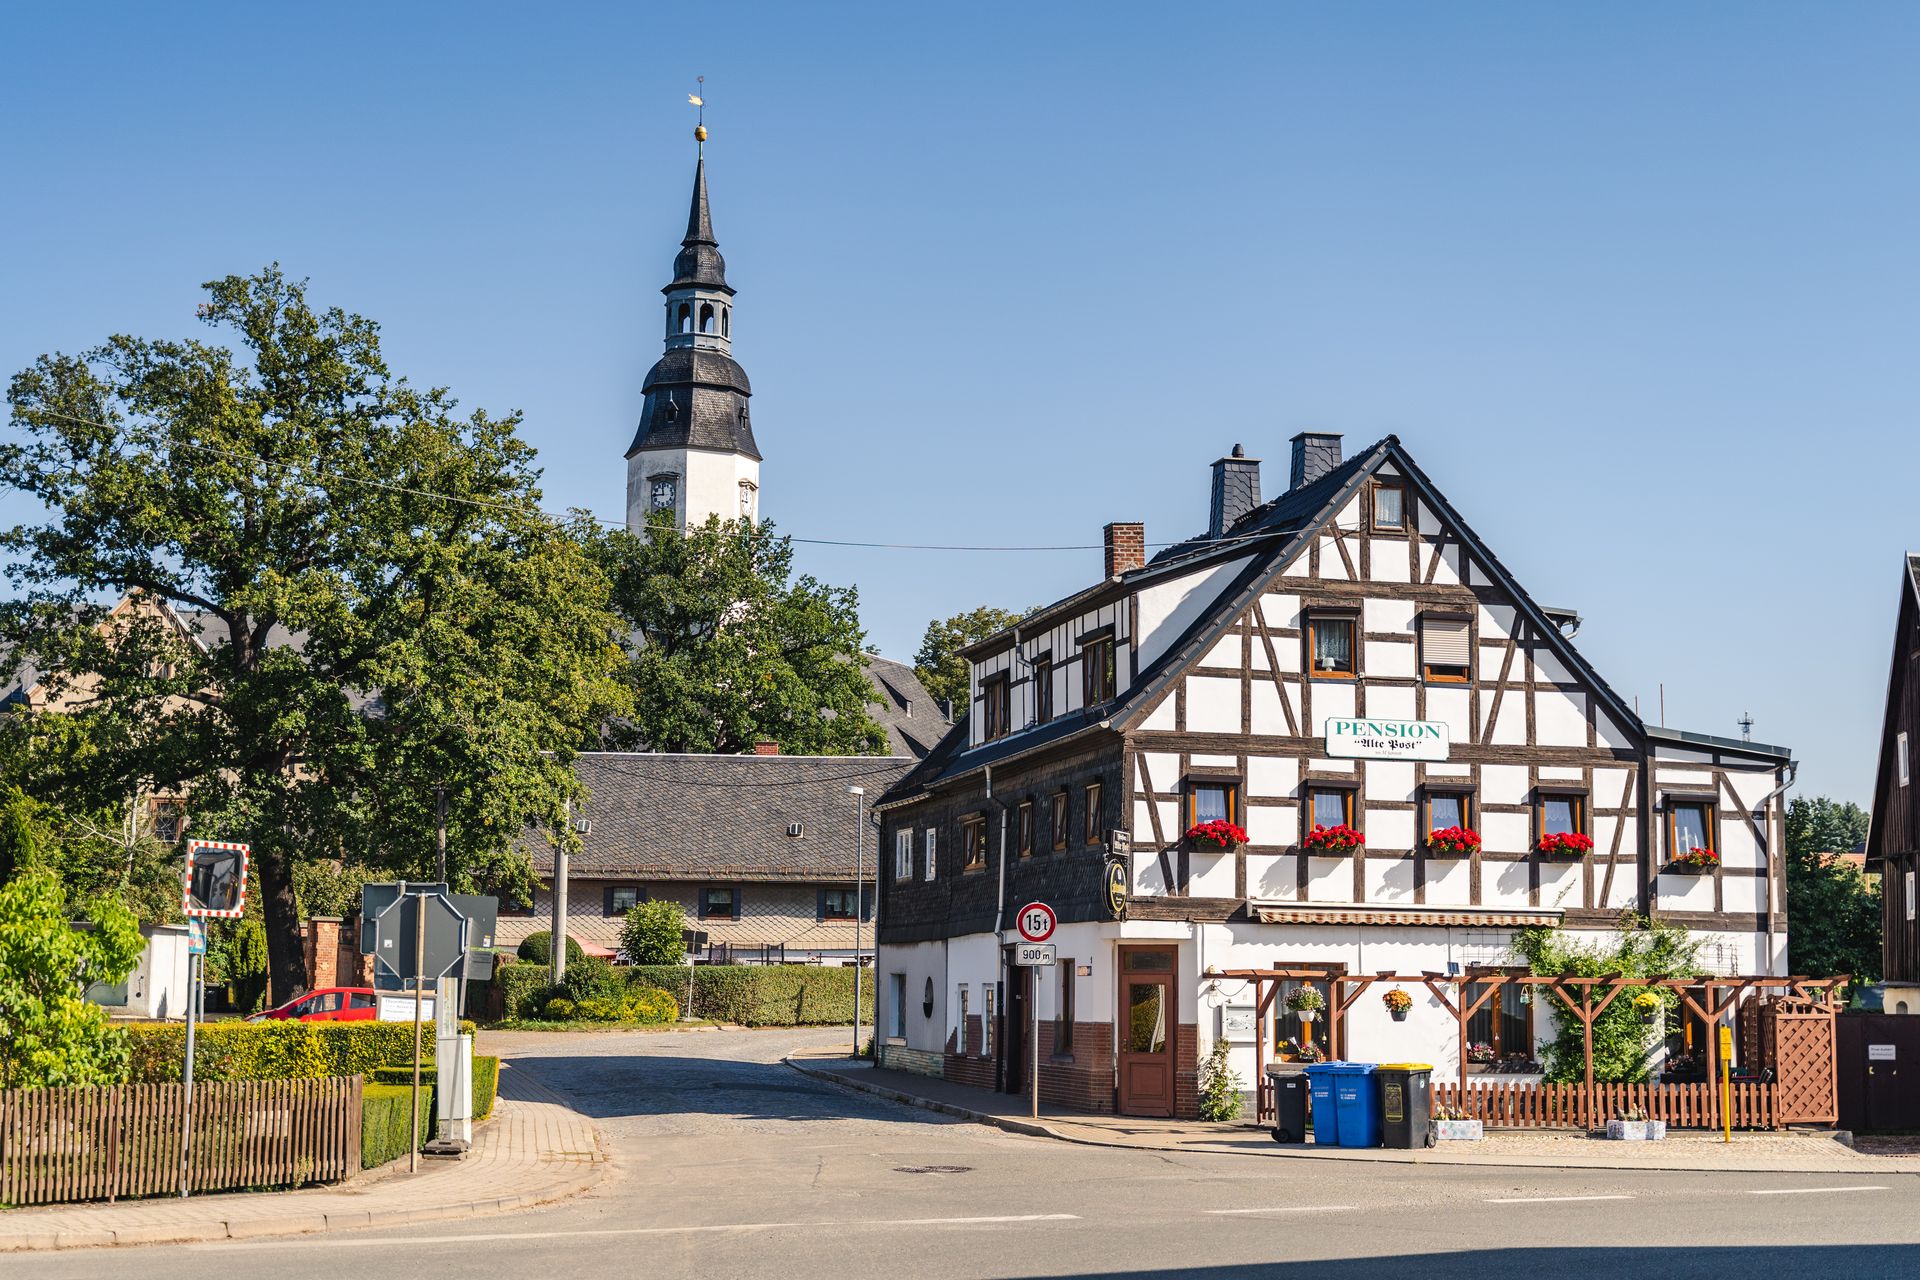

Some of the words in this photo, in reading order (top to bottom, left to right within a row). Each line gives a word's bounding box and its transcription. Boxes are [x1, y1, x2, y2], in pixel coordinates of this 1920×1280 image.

[1336, 721, 1440, 739] PENSION
[1026, 914, 1041, 931] 15
[1043, 918, 1048, 931] t
[1022, 949, 1041, 960] 900
